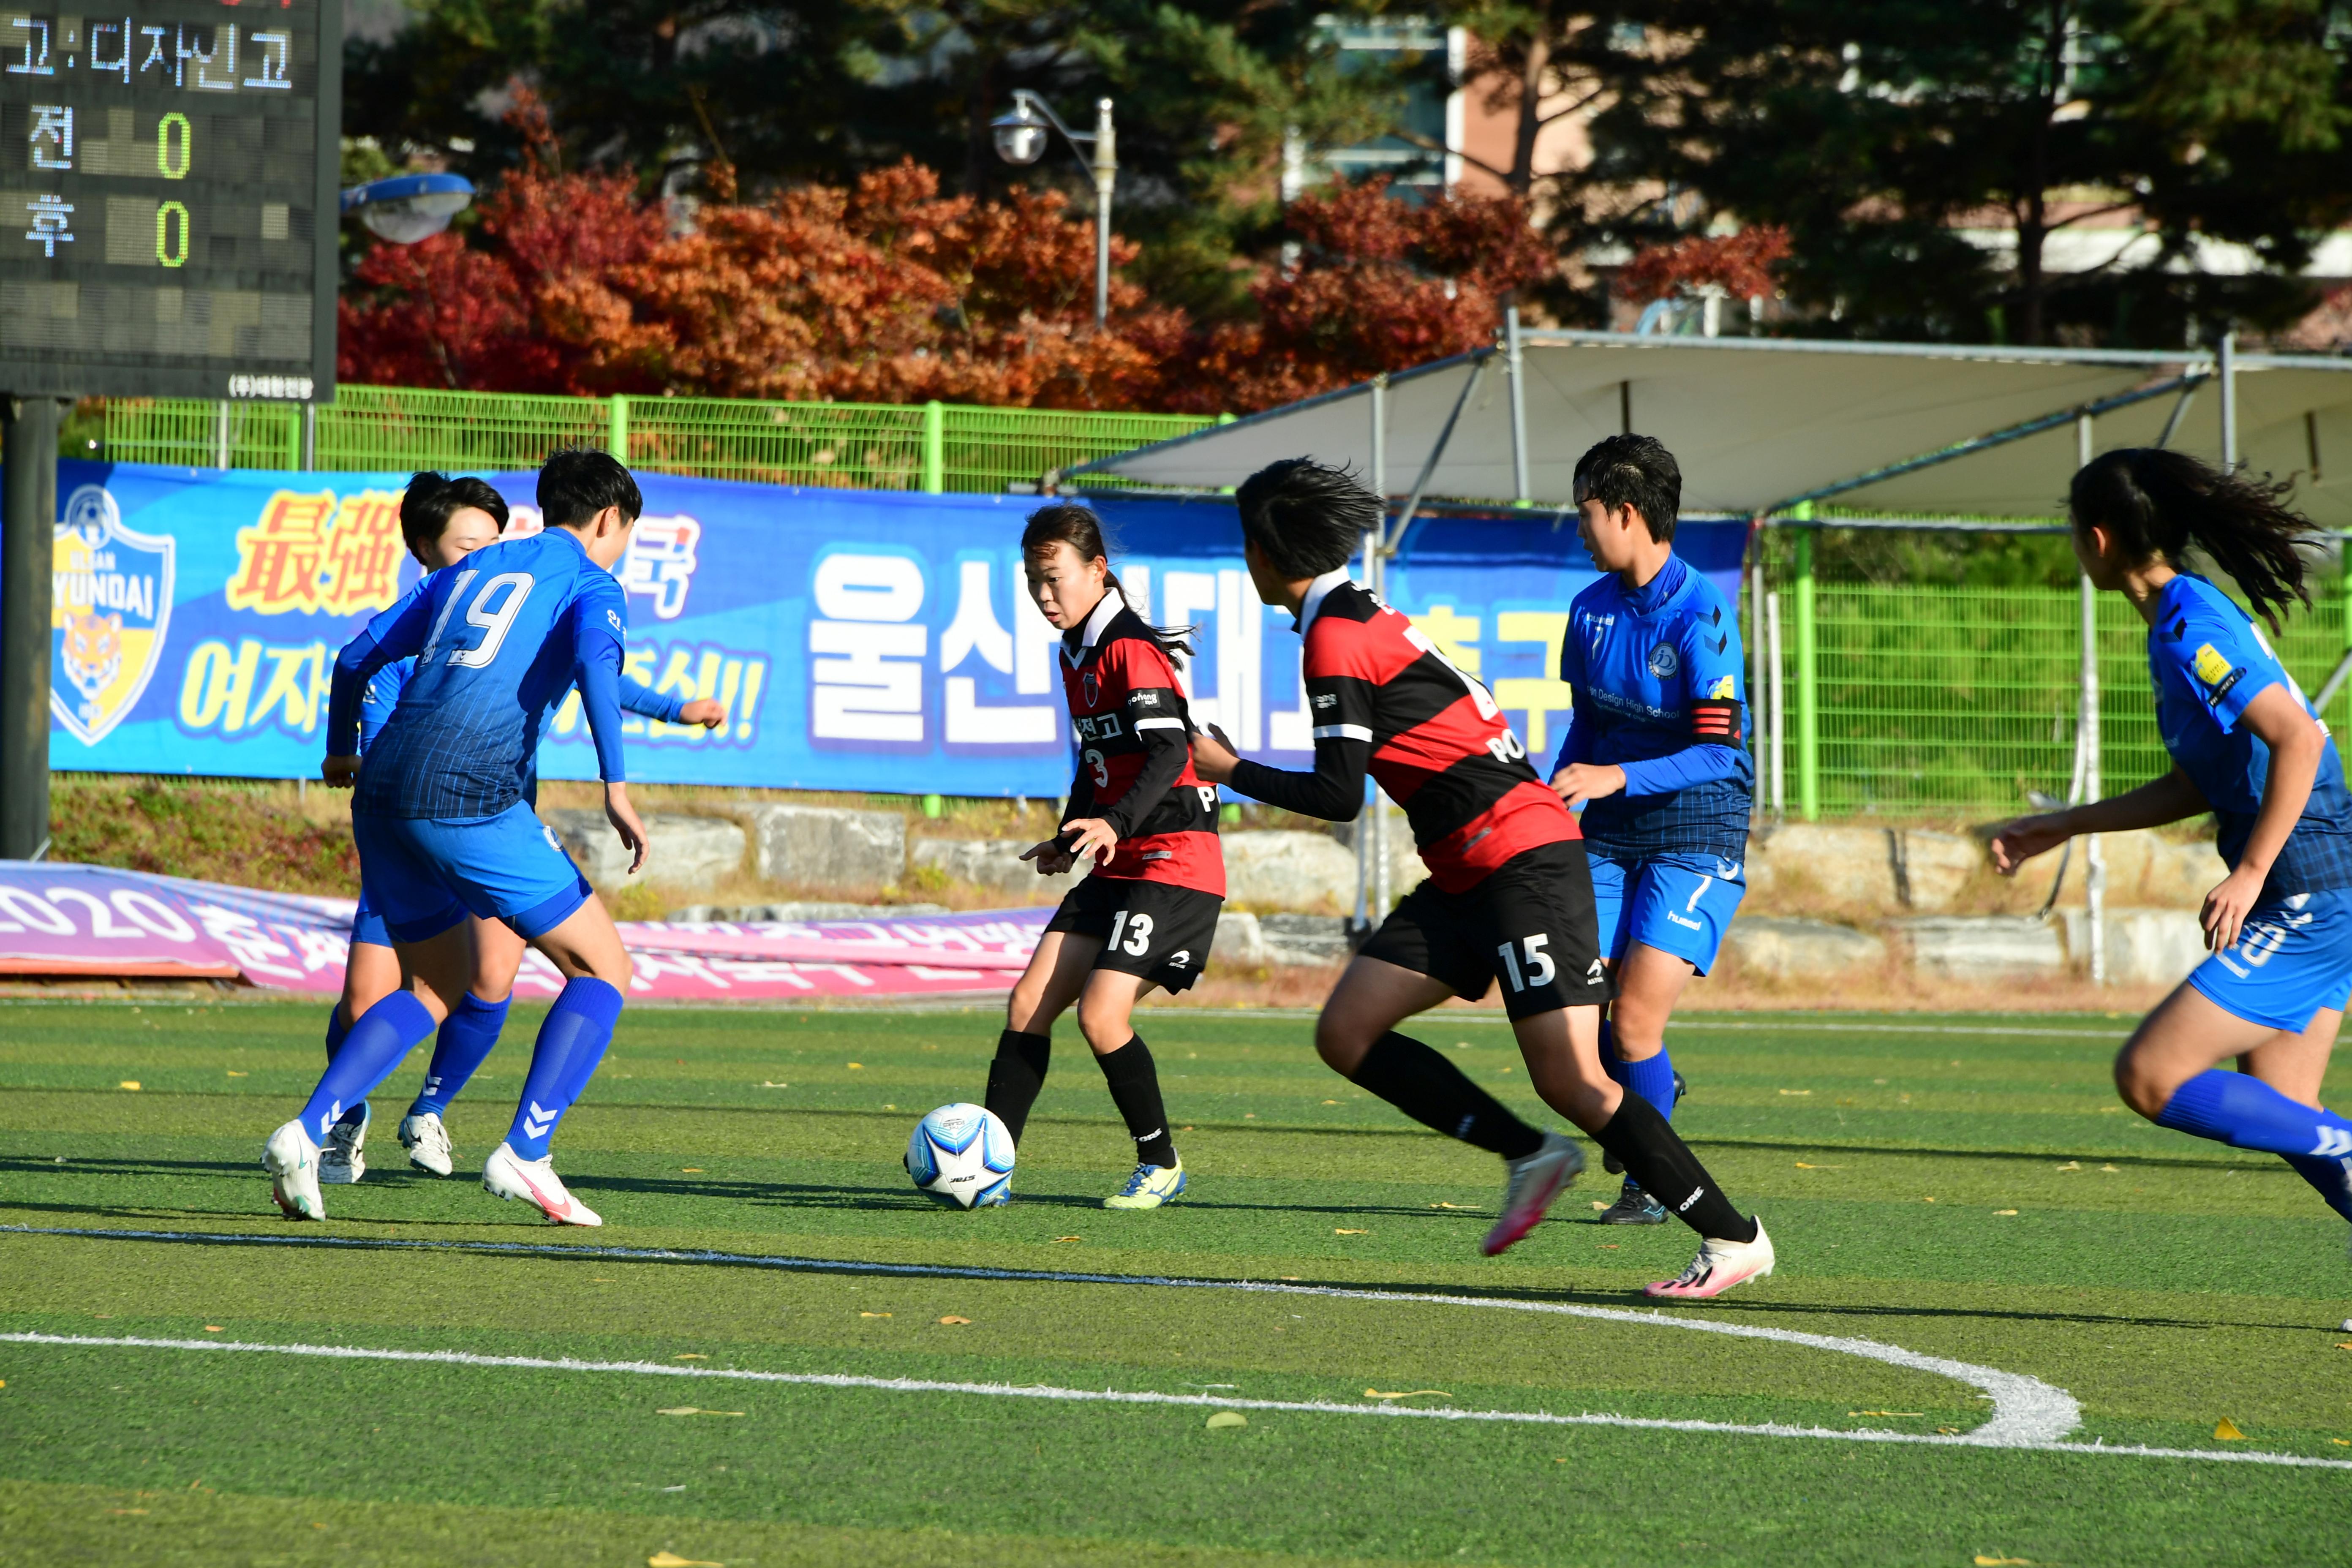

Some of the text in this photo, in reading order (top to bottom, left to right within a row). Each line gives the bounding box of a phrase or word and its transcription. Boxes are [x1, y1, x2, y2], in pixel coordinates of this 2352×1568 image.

[30, 105, 72, 169] 전
[158, 112, 191, 179] 0
[25, 195, 74, 257] 후
[156, 201, 188, 267] 0
[52, 571, 153, 620] YUNDAI
[421, 569, 536, 669] 19
[1592, 626, 1603, 659] 7
[1074, 713, 1123, 741] 전고
[1598, 689, 1623, 707] Design
[1626, 698, 1644, 713] High
[1647, 705, 1680, 719] School
[1686, 873, 1712, 913] 7
[1107, 910, 1154, 956] 13
[1667, 910, 1701, 931] hummel
[1497, 933, 1555, 992] 15
[1133, 1127, 1162, 1142] ORE
[1674, 1186, 1704, 1214] ORE
